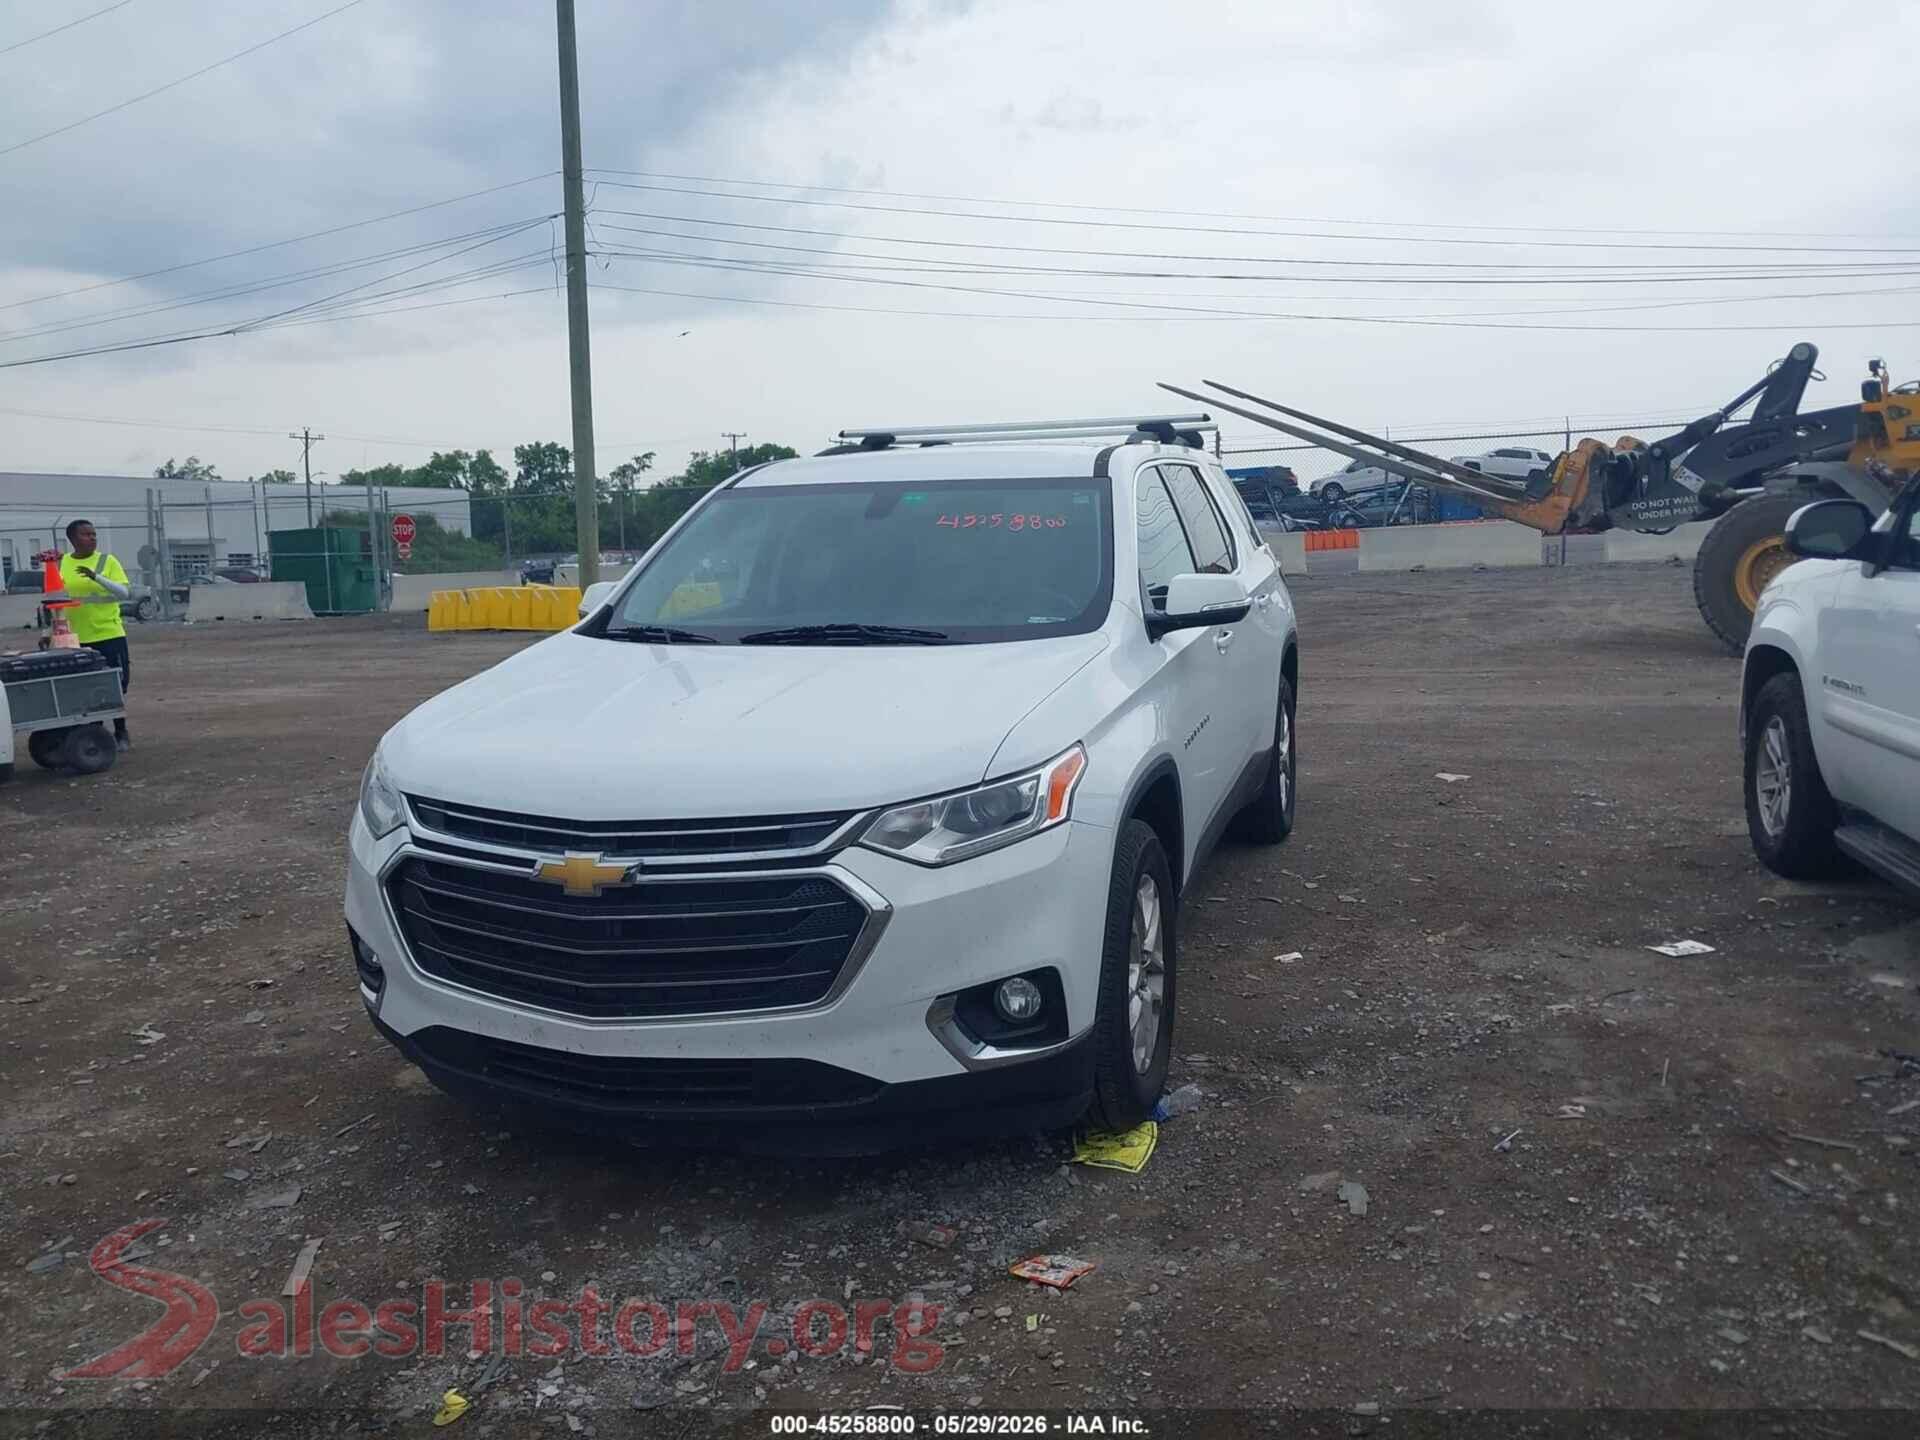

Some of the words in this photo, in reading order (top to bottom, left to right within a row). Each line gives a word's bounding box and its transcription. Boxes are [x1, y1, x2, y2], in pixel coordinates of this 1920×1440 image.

[1632, 501, 1647, 511] DO
[1649, 497, 1671, 508] NOT
[1638, 509, 1673, 520] UNDER
[393, 524, 415, 536] STOP
